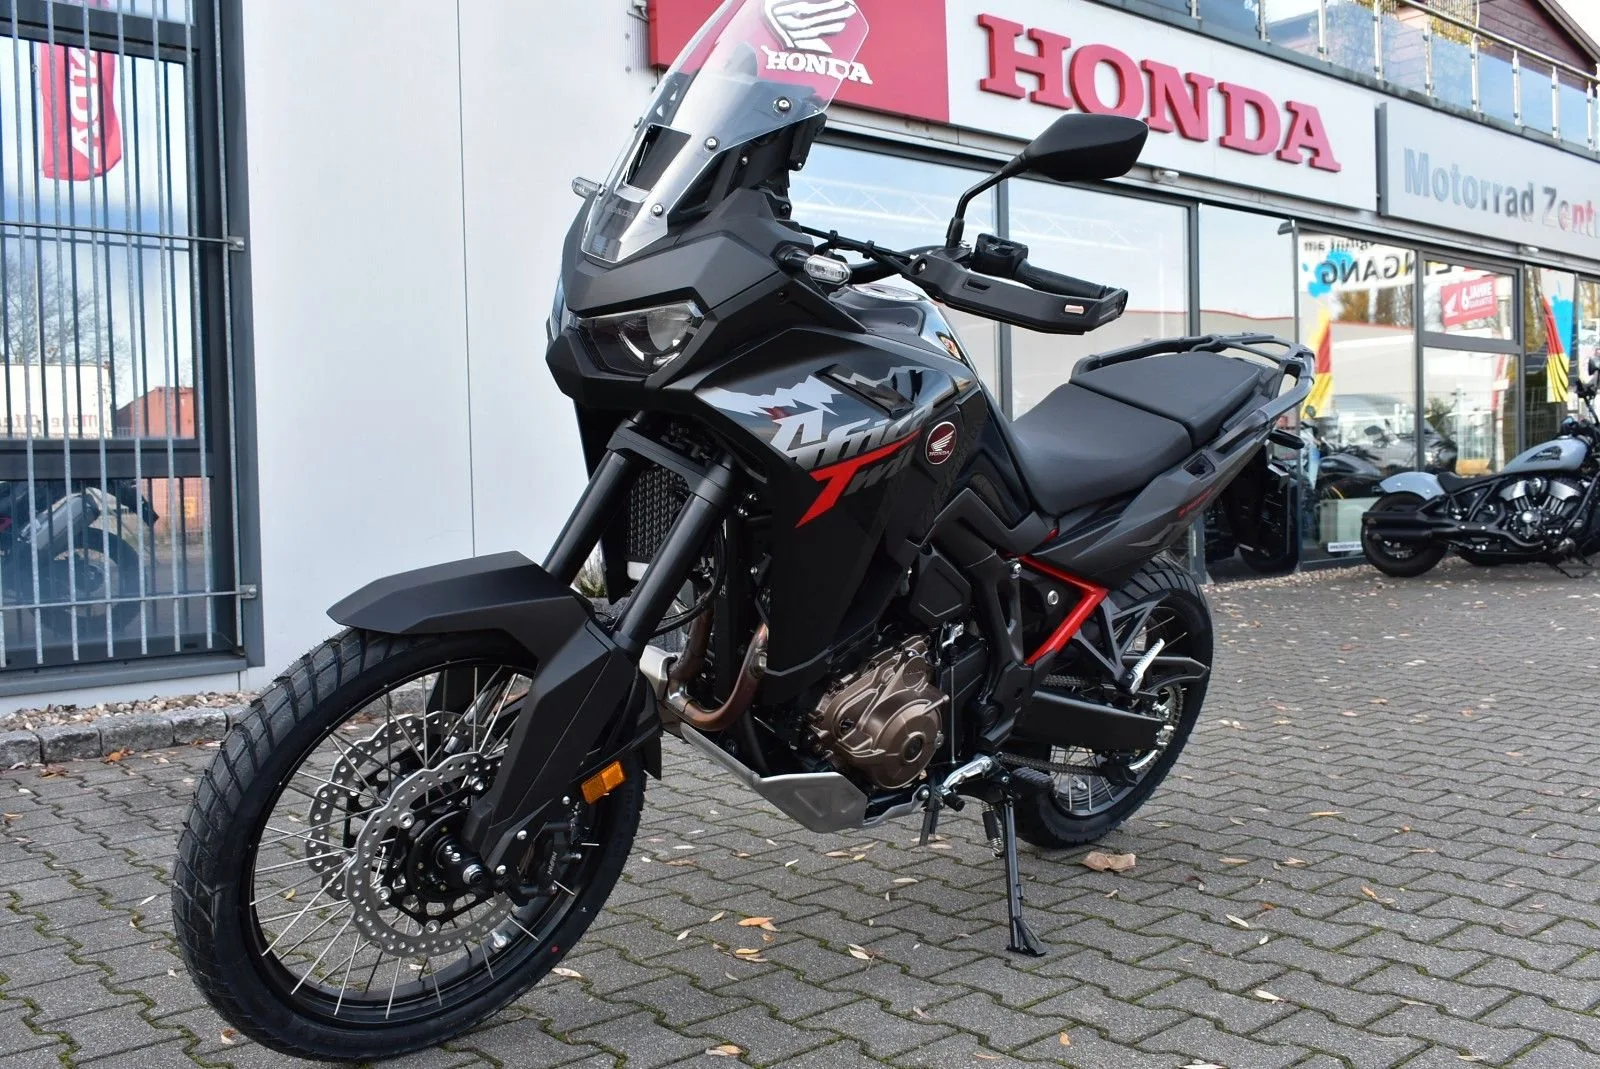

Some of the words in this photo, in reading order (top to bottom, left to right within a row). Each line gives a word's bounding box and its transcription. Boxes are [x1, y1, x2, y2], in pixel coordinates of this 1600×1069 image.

[763, 46, 873, 85] HONDA
[978, 13, 1342, 173] HONDA
[1404, 146, 1535, 223] Motorrad
[1461, 286, 1469, 311] 6
[1469, 280, 1493, 300] JAHRE
